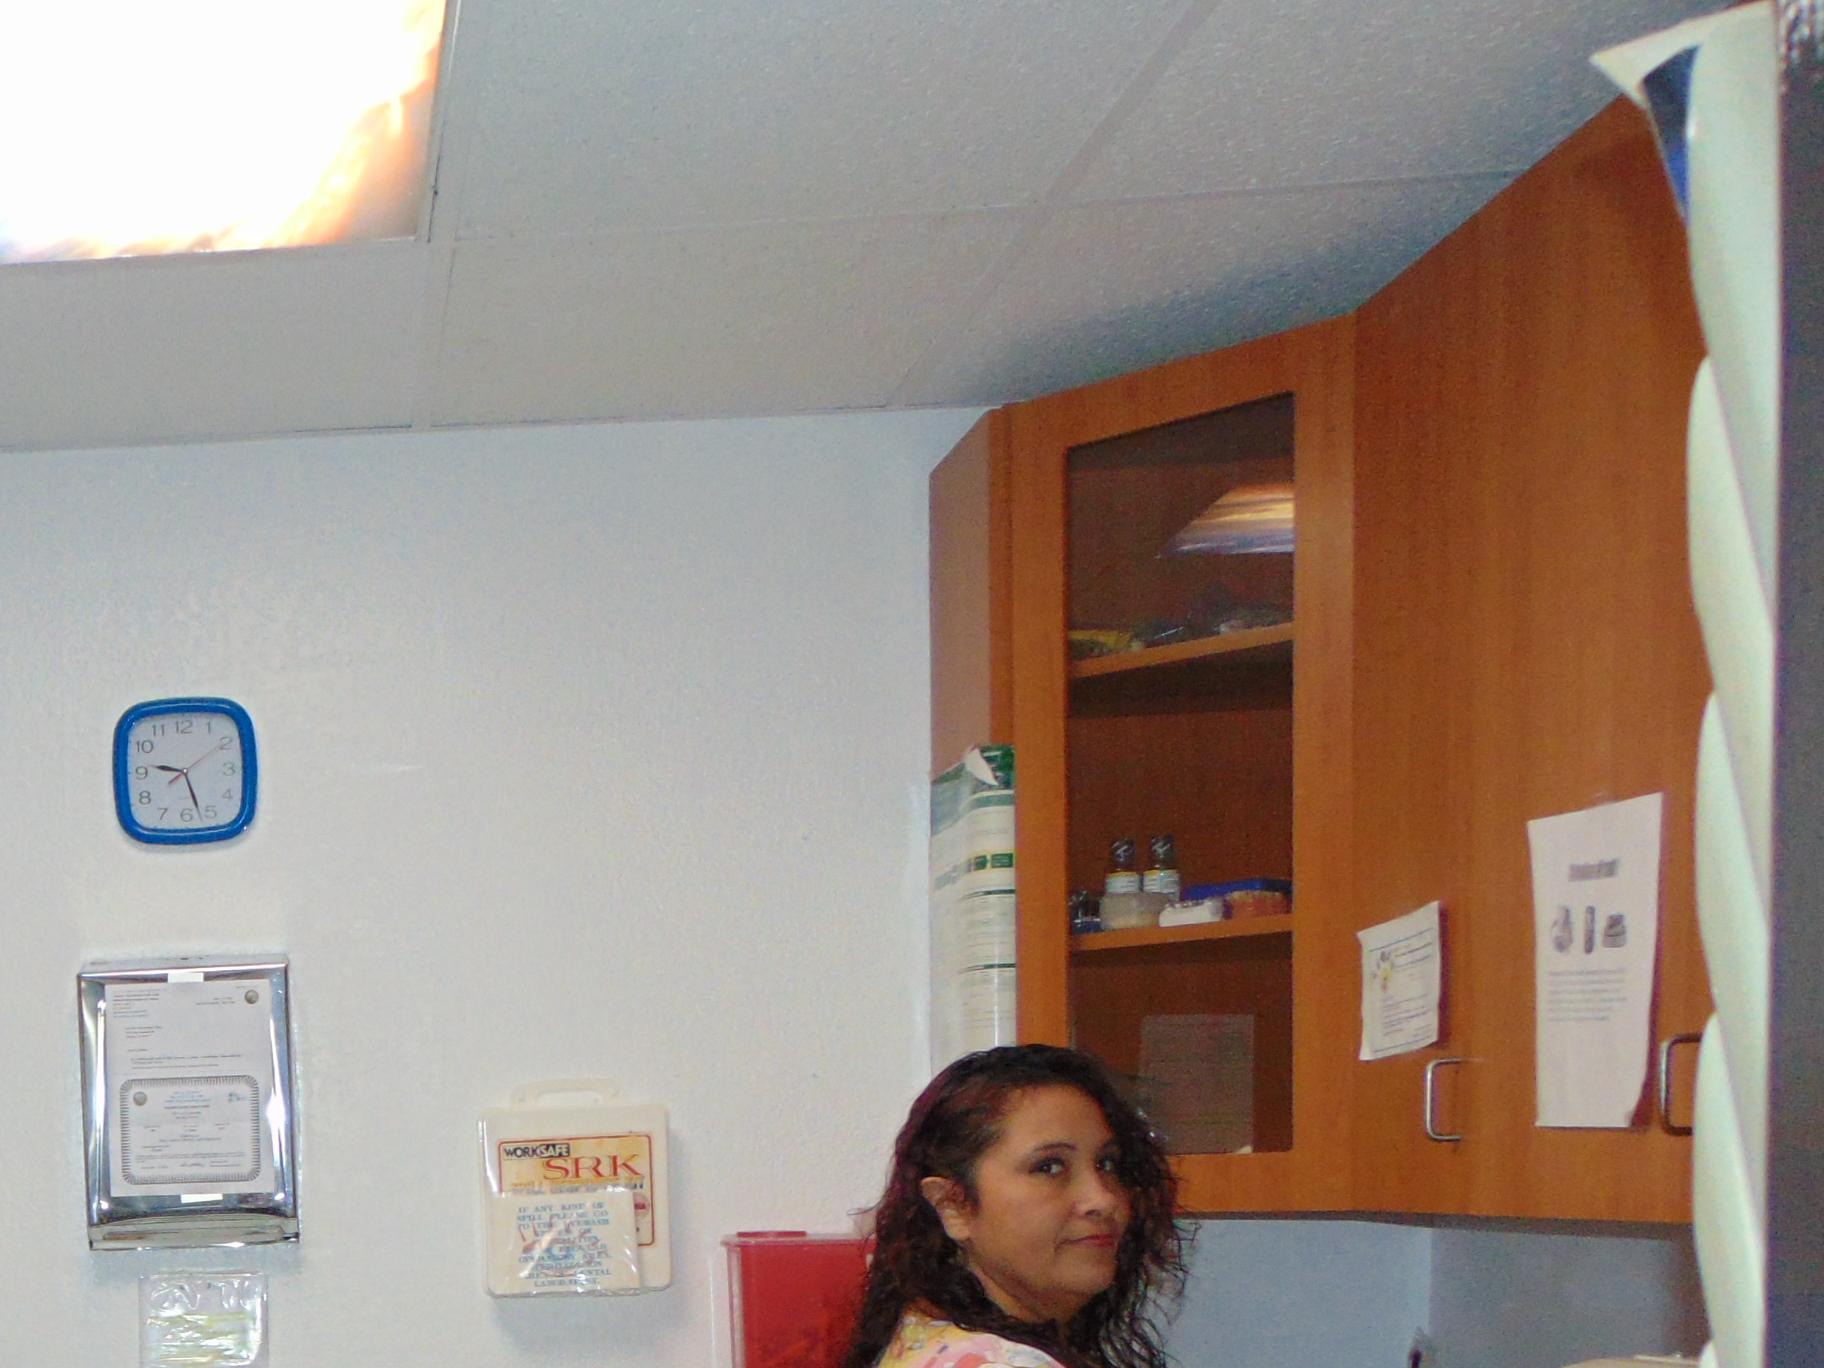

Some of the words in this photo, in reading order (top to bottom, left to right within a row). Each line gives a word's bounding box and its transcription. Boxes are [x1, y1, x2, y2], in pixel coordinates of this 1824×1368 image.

[152, 724, 166, 737] 11
[175, 719, 193, 734] 12
[206, 721, 212, 735] 1
[136, 739, 154, 754] 10
[219, 736, 234, 751] 2
[135, 765, 149, 780] 9
[222, 761, 237, 777] 3
[138, 790, 152, 805] 8
[222, 788, 234, 801] 4
[157, 807, 169, 821] 7
[180, 808, 194, 823] 6
[205, 805, 218, 819] 5
[503, 1142, 570, 1158] WORKSAFE
[543, 1154, 643, 1180] SRK
